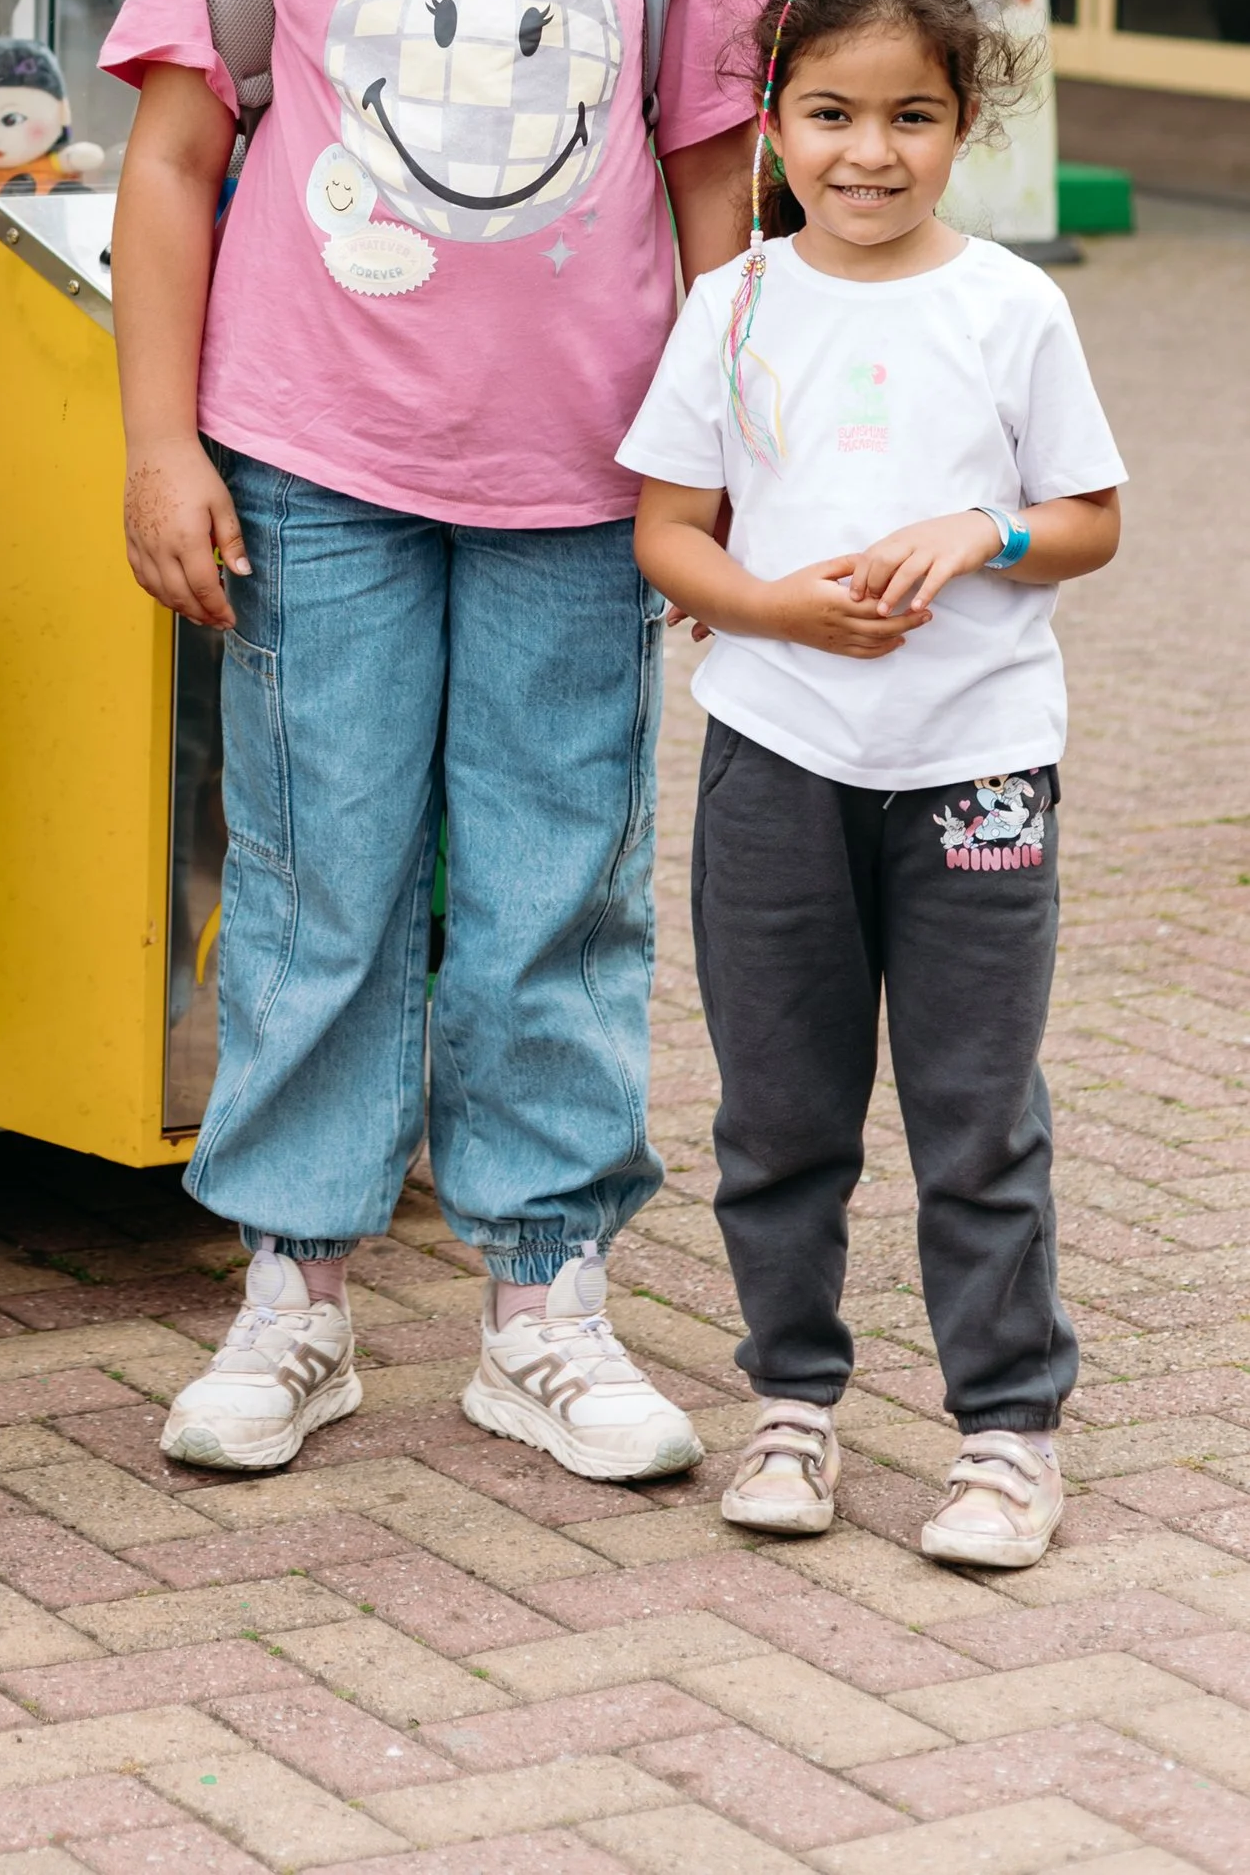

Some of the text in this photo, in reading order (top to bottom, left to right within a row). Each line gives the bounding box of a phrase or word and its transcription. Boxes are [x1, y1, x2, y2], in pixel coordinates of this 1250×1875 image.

[348, 238, 412, 259] WHATEVER
[349, 263, 404, 280] FOREVER
[837, 424, 889, 439] SUNSHINE
[946, 845, 1044, 872] MINNIE
